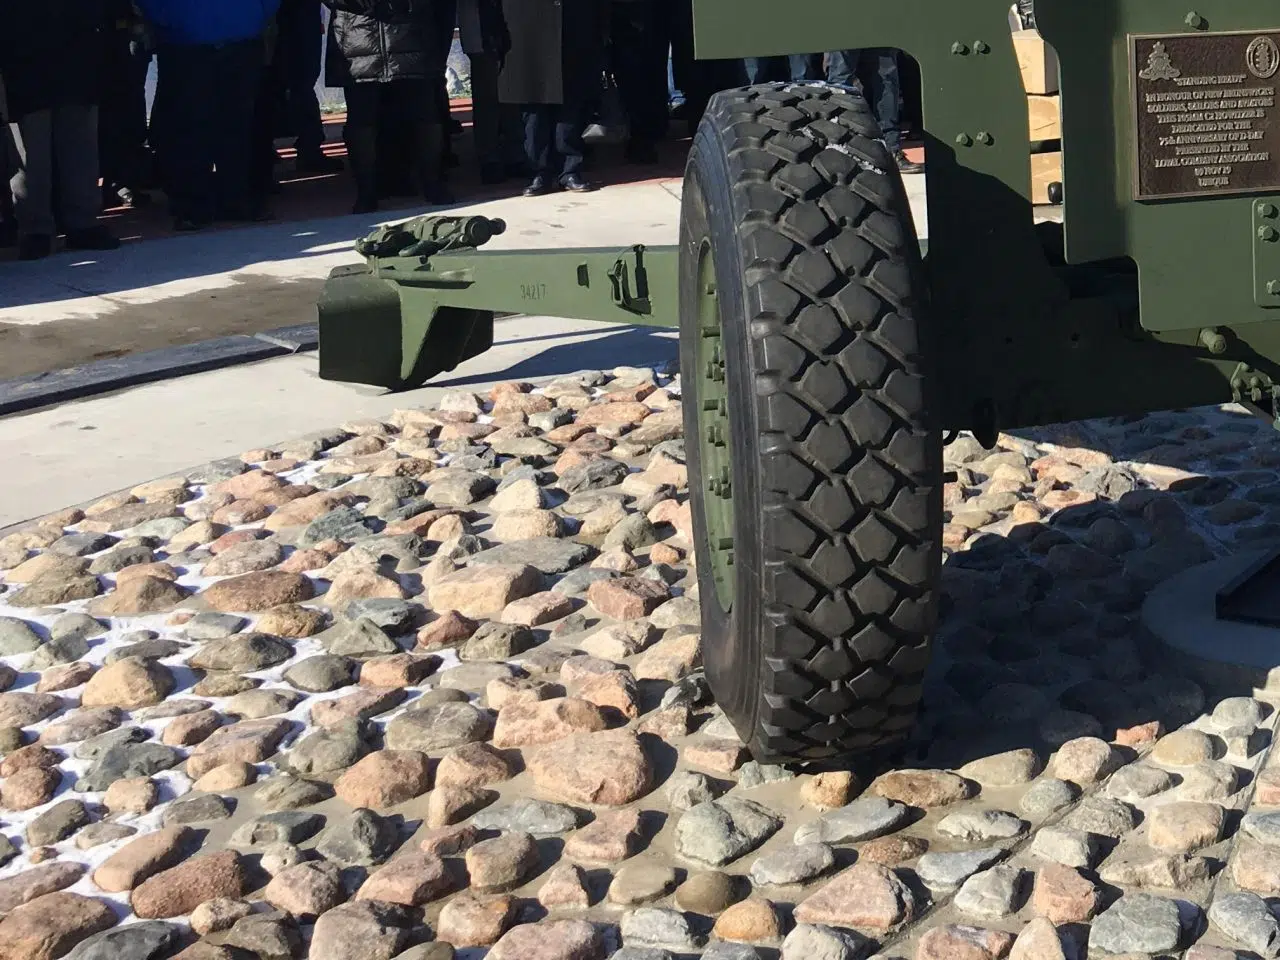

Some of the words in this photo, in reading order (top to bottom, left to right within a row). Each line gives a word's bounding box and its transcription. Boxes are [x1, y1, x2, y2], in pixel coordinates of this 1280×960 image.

[1146, 94, 1156, 102] IN
[1157, 93, 1192, 101] HONOUR
[1193, 92, 1203, 100] OF
[1204, 91, 1223, 99] NEW
[1188, 101, 1219, 110] SAILORS
[1220, 100, 1236, 108] AND
[1238, 97, 1274, 107] AVIATORS
[1157, 114, 1176, 123] THIS
[1215, 110, 1254, 119] HOWITZER
[1256, 109, 1264, 117] IS
[1172, 124, 1216, 133] DEDICATED
[1217, 122, 1234, 130] FOR
[1235, 121, 1252, 129] THE
[1177, 132, 1228, 143] ANNIVERSARY
[1228, 132, 1239, 140] OF
[1176, 145, 1220, 155] PRESENTED
[1221, 144, 1231, 152] BY
[1232, 143, 1249, 152] THE
[1155, 159, 1180, 167] LOYAL
[1181, 155, 1218, 166] COMPANY
[1219, 152, 1269, 163] ASSOCIATION
[1205, 166, 1221, 175] NOV
